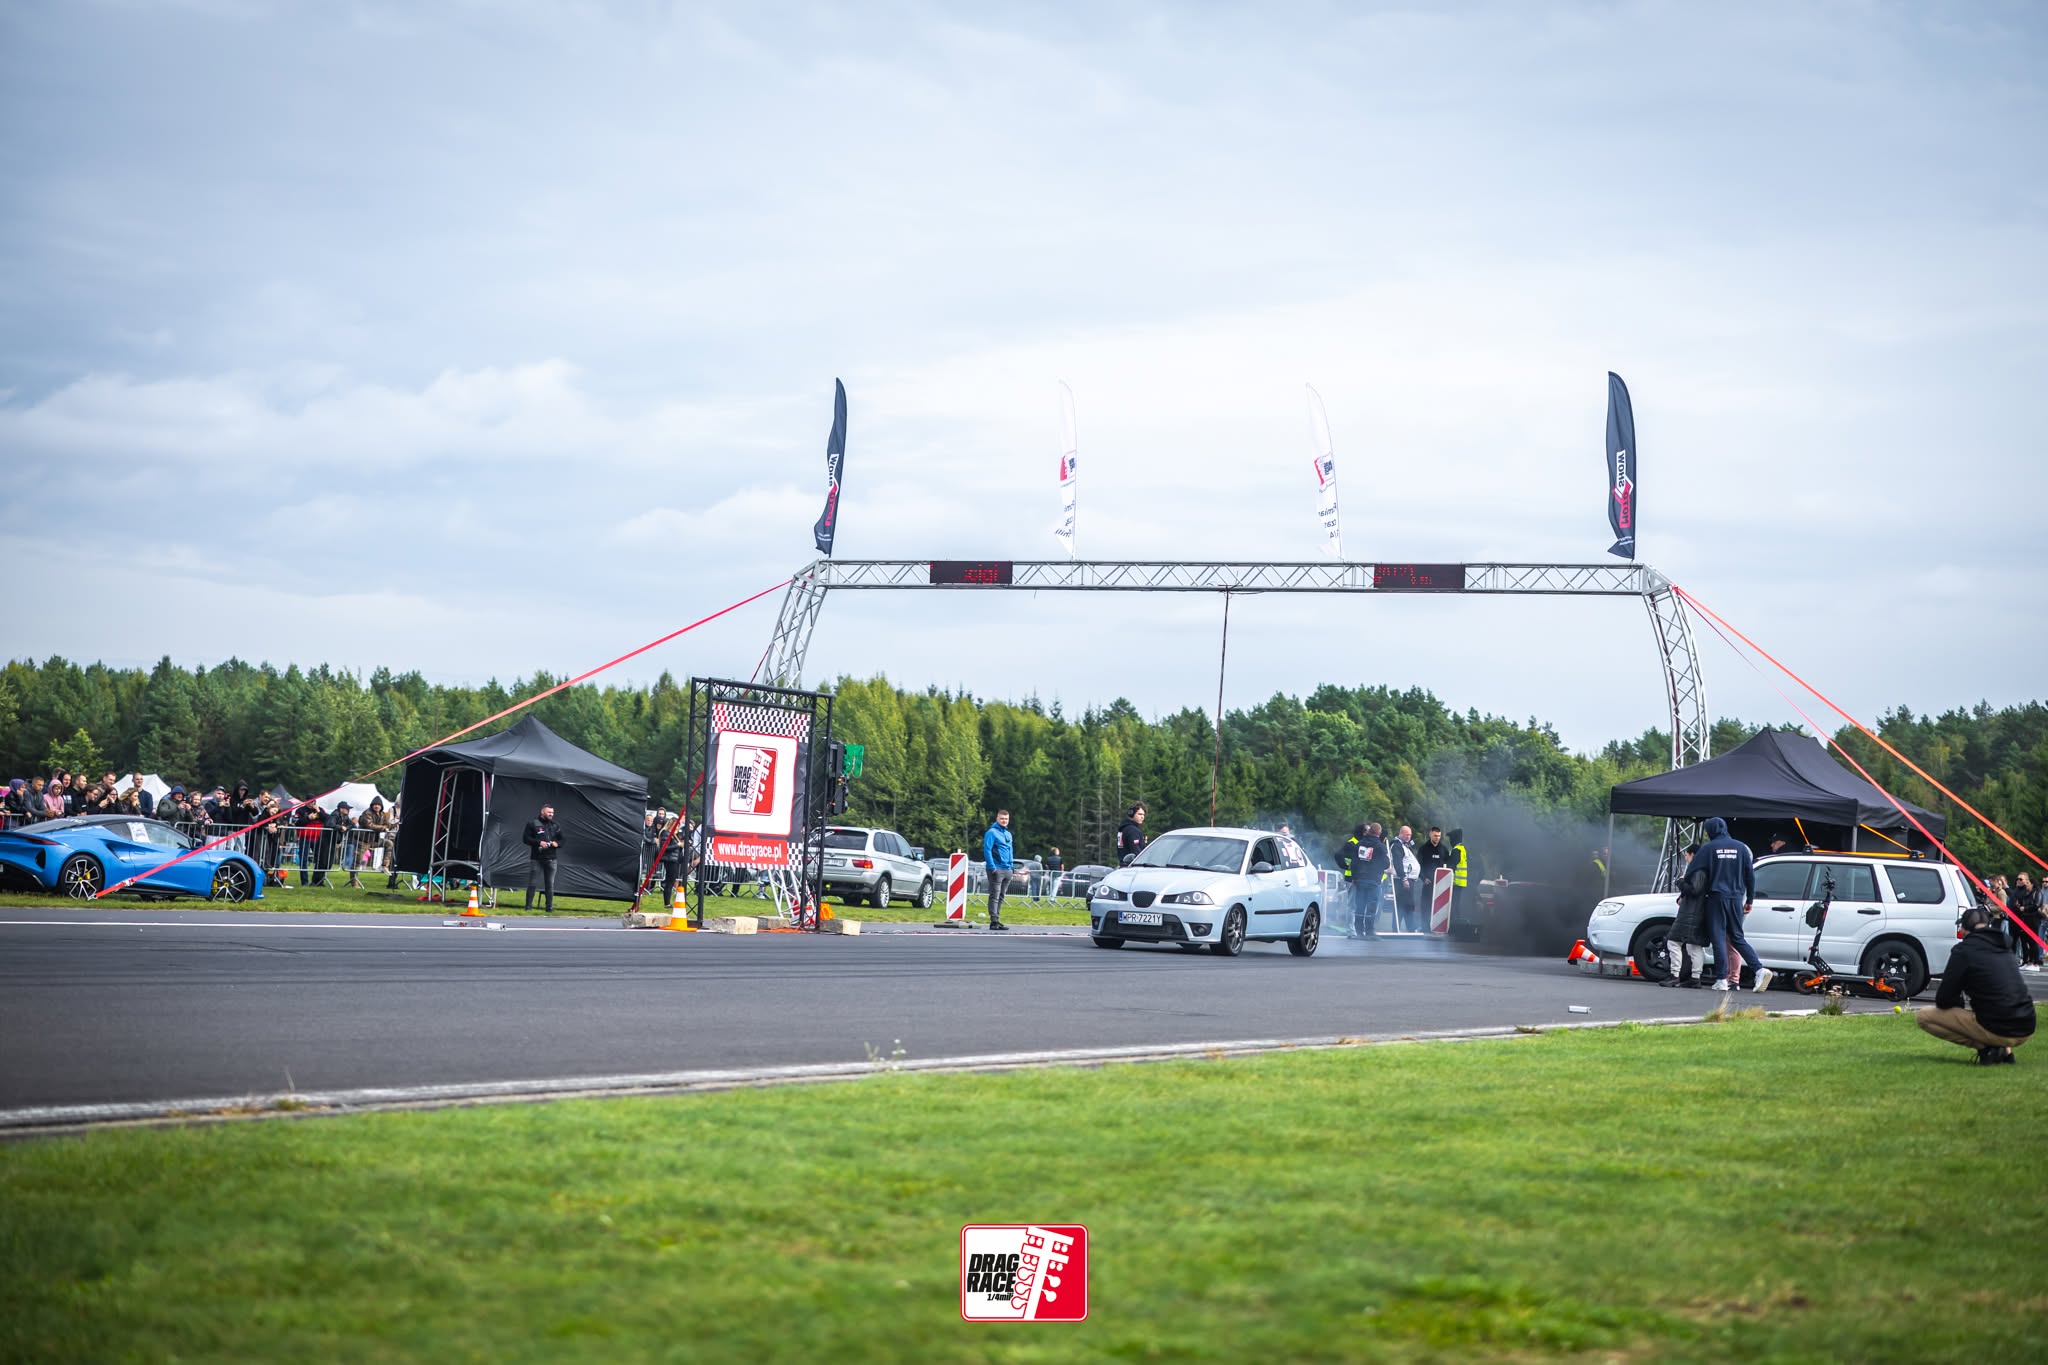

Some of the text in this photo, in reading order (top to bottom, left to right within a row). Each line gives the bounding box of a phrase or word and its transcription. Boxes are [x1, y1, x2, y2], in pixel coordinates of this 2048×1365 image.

[734, 765, 752, 779] DRAG
[733, 779, 750, 793] RACE
[718, 841, 782, 861] www.dragrace.pl
[1138, 914, 1161, 923] 7221Y
